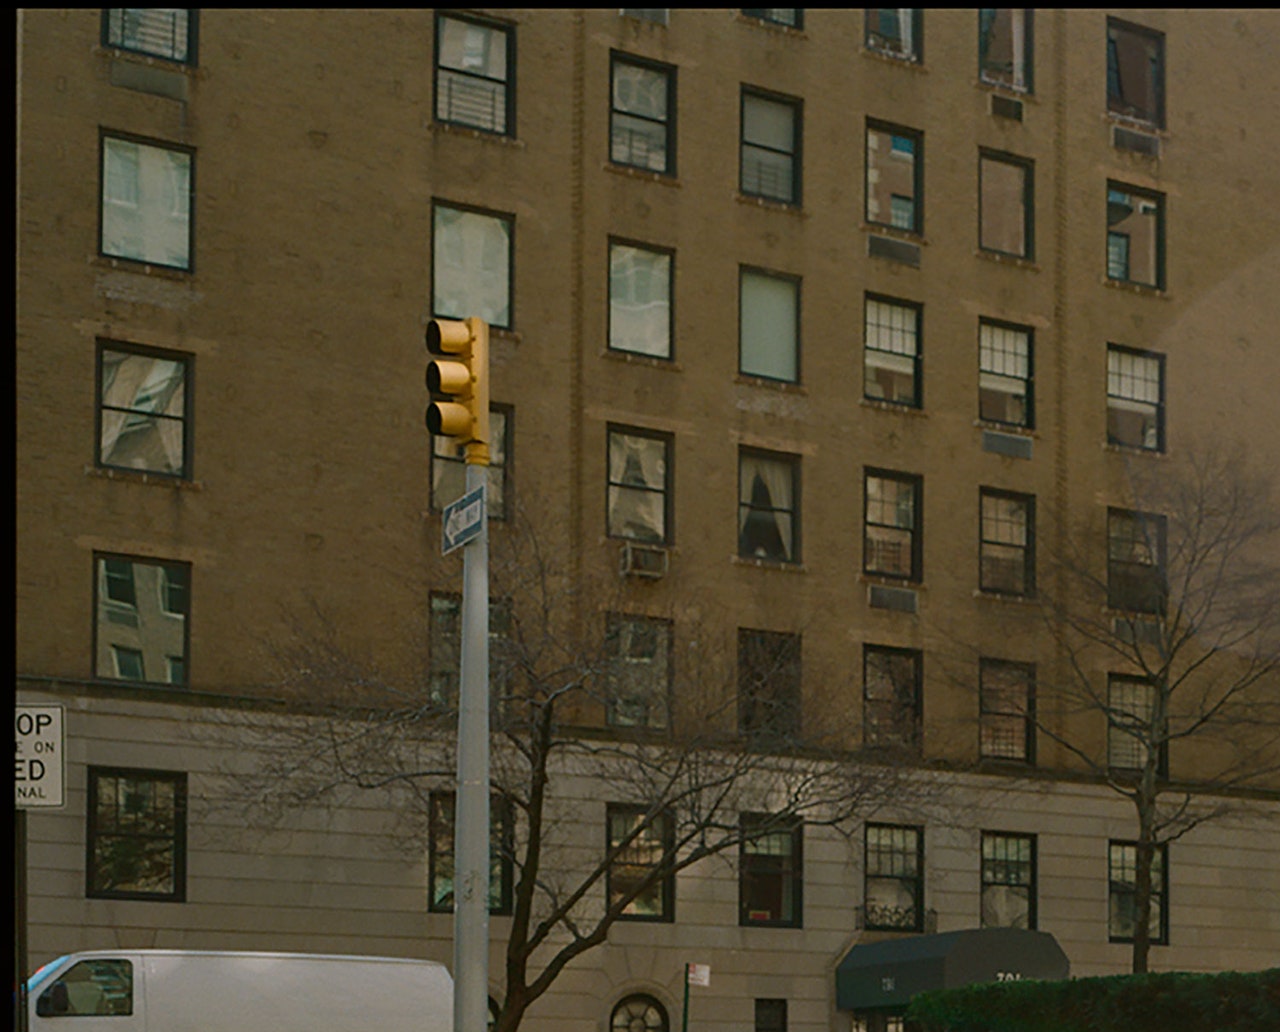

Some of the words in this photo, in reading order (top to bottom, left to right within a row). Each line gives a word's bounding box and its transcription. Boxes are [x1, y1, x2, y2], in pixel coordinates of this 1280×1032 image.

[17, 713, 52, 736] OP
[34, 741, 54, 753] ON
[17, 787, 46, 798] NAL
